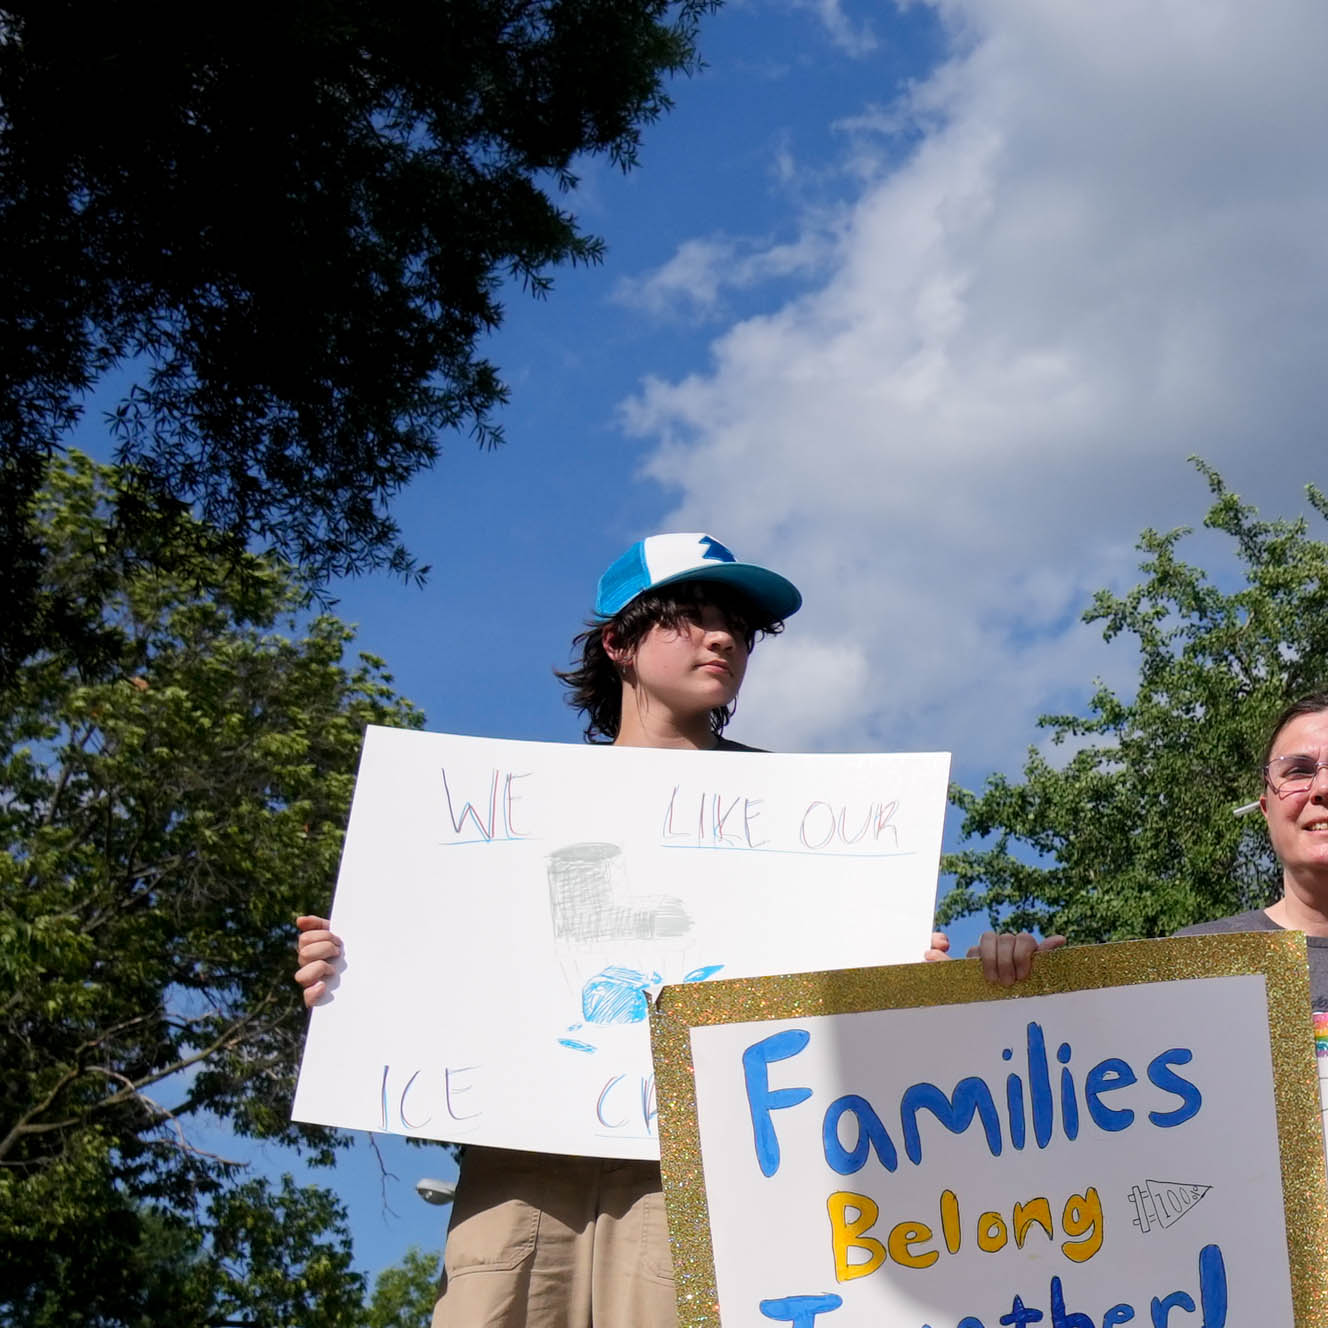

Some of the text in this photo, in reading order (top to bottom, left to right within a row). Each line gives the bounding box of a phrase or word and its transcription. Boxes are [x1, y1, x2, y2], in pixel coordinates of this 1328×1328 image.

[442, 769, 899, 849] WE LIKE OUR
[377, 1064, 482, 1131] ICE
[741, 1020, 1203, 1178] Families
[827, 1185, 1105, 1282] Belong
